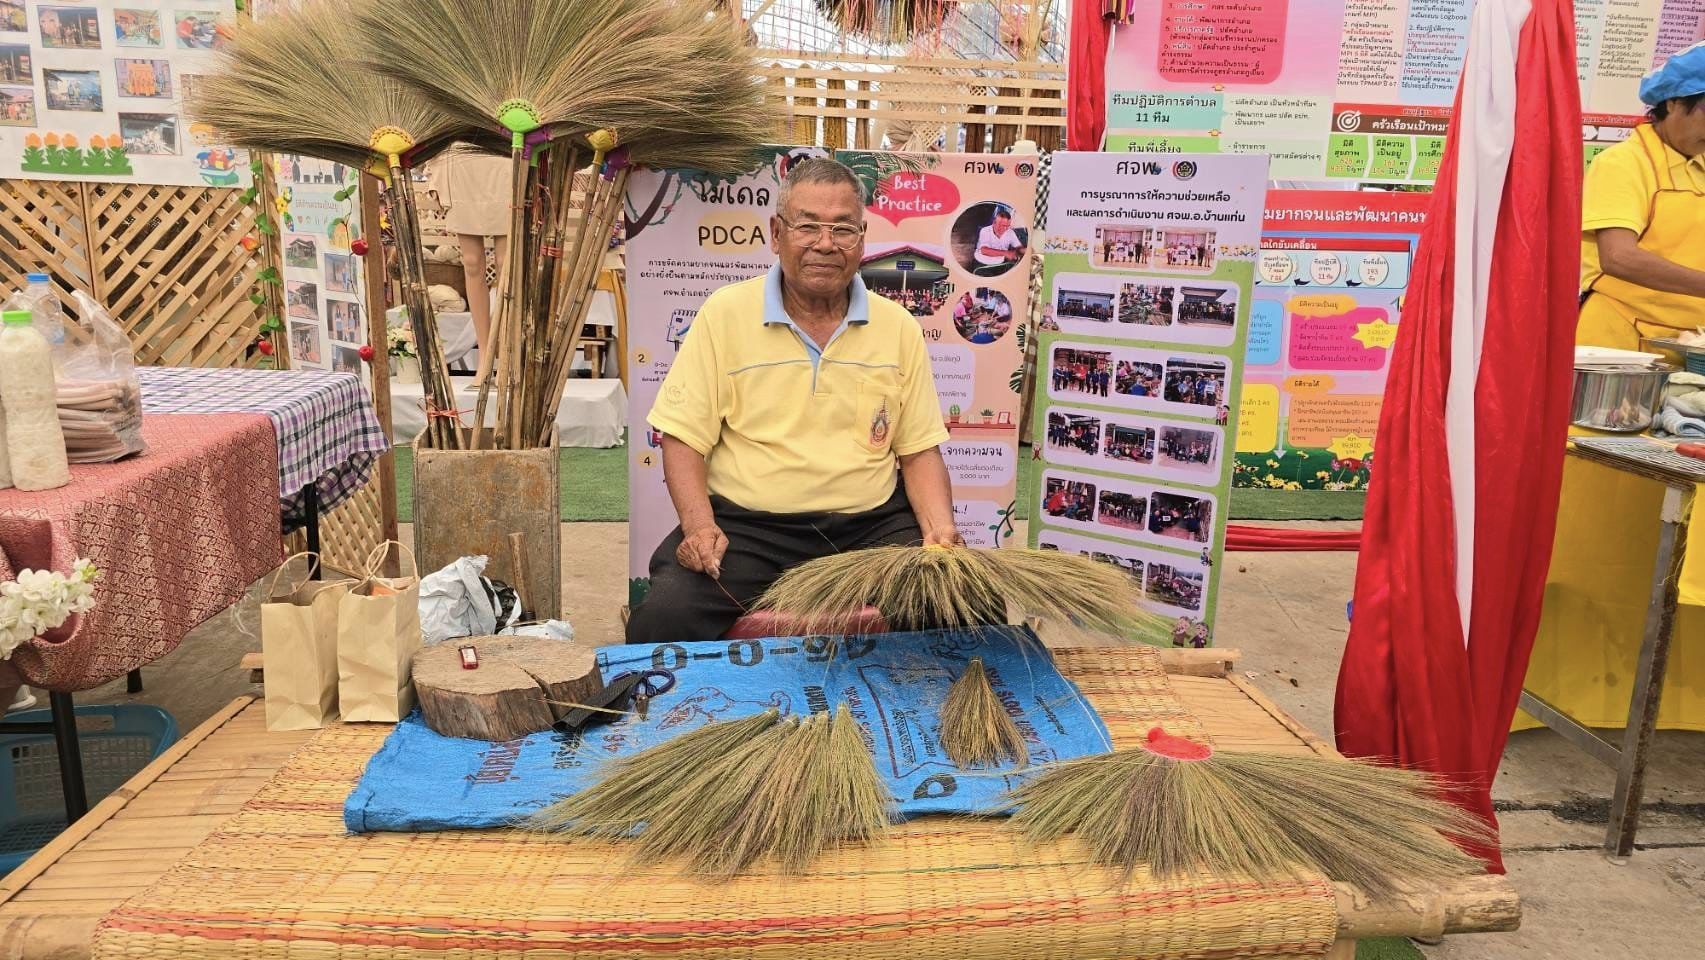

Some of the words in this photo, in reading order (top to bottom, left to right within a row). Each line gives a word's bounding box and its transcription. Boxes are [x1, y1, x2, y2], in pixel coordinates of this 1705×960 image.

[1112, 92, 1217, 109] ทีมปฏิบัติการตำบล
[1135, 112, 1149, 123] 11
[1153, 111, 1170, 123] ทีม
[893, 174, 927, 191] Best
[1080, 188, 1231, 203] การบูรณาการให้ความช่วยเหลือ
[876, 195, 943, 213] Practice
[1066, 206, 1164, 220] และผลการดำเนินงาน
[1166, 209, 1246, 222] ศจพ.อ.บ้านแท่น
[698, 225, 766, 246] PDCA
[638, 353, 646, 363] 2
[643, 456, 652, 466] 4
